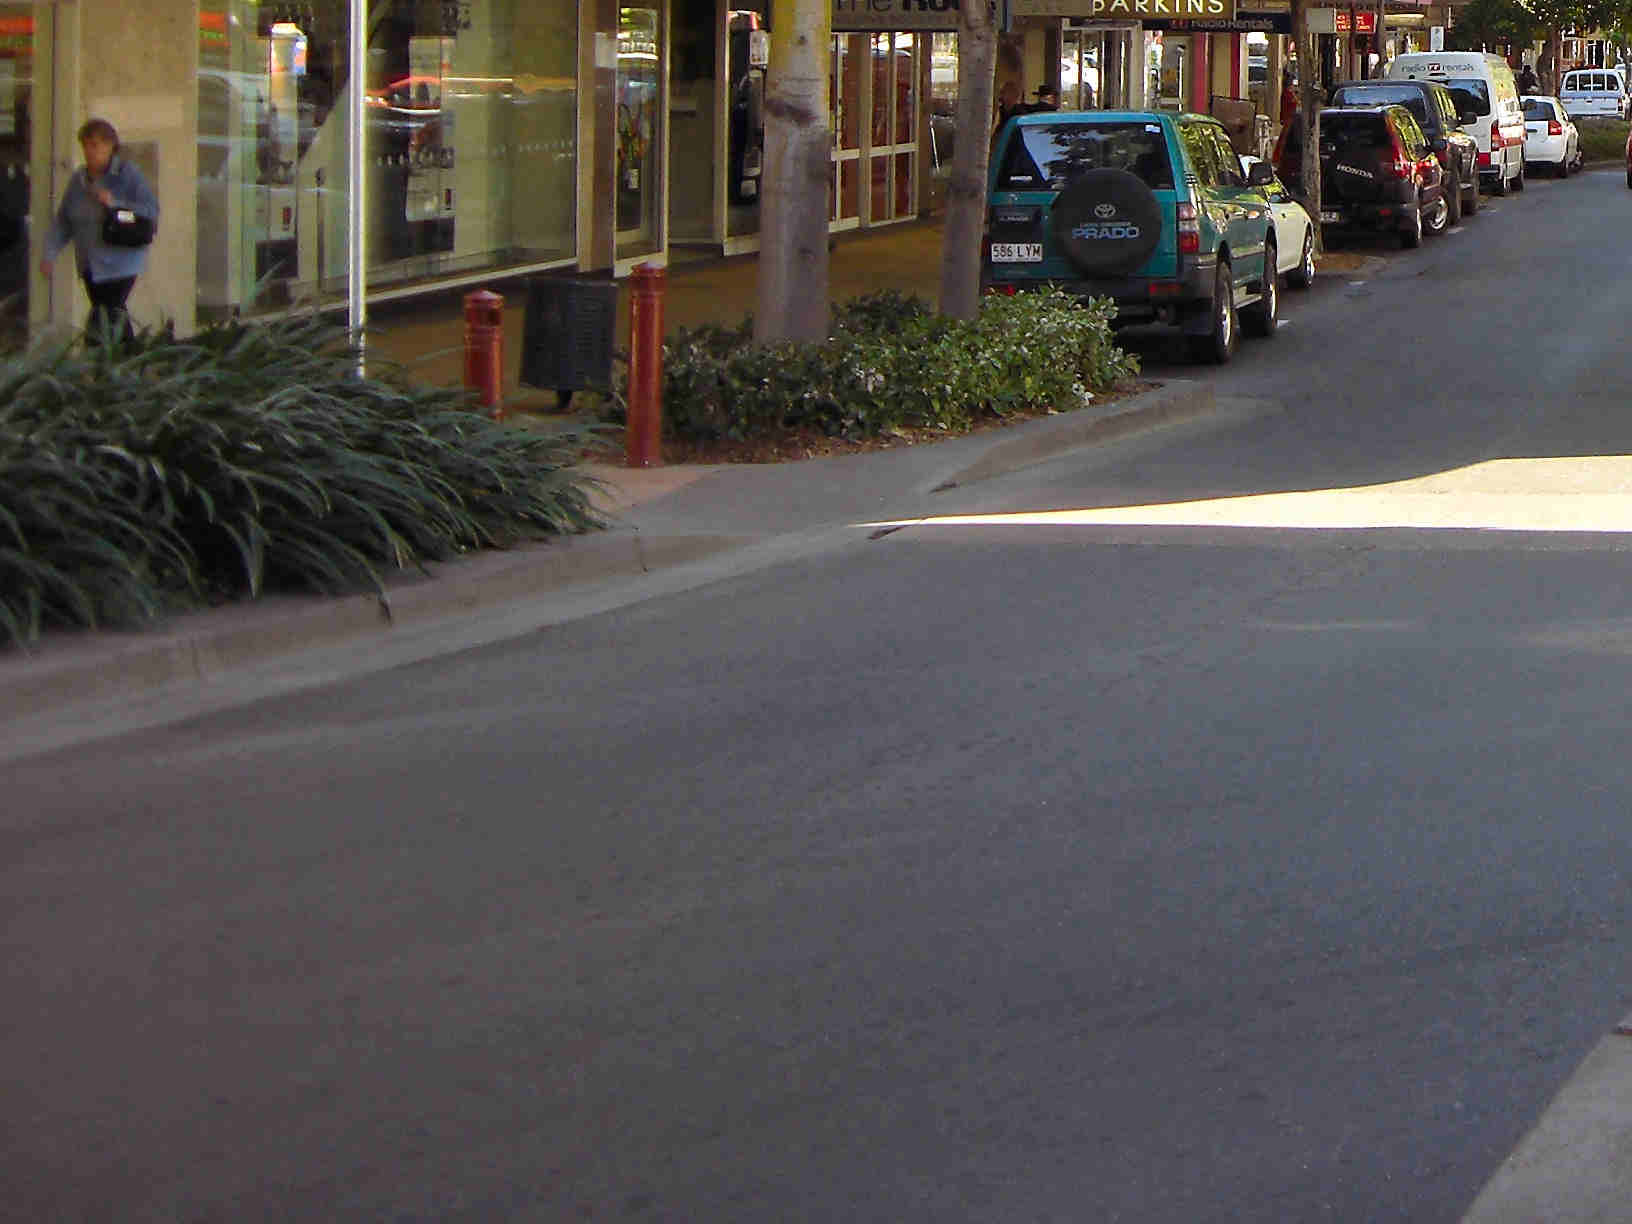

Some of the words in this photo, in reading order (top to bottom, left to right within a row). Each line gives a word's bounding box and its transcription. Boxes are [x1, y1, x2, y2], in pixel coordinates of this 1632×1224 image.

[1336, 162, 1374, 178] HONDA
[1072, 226, 1140, 239] PRADO
[1017, 245, 1041, 258] LYM
